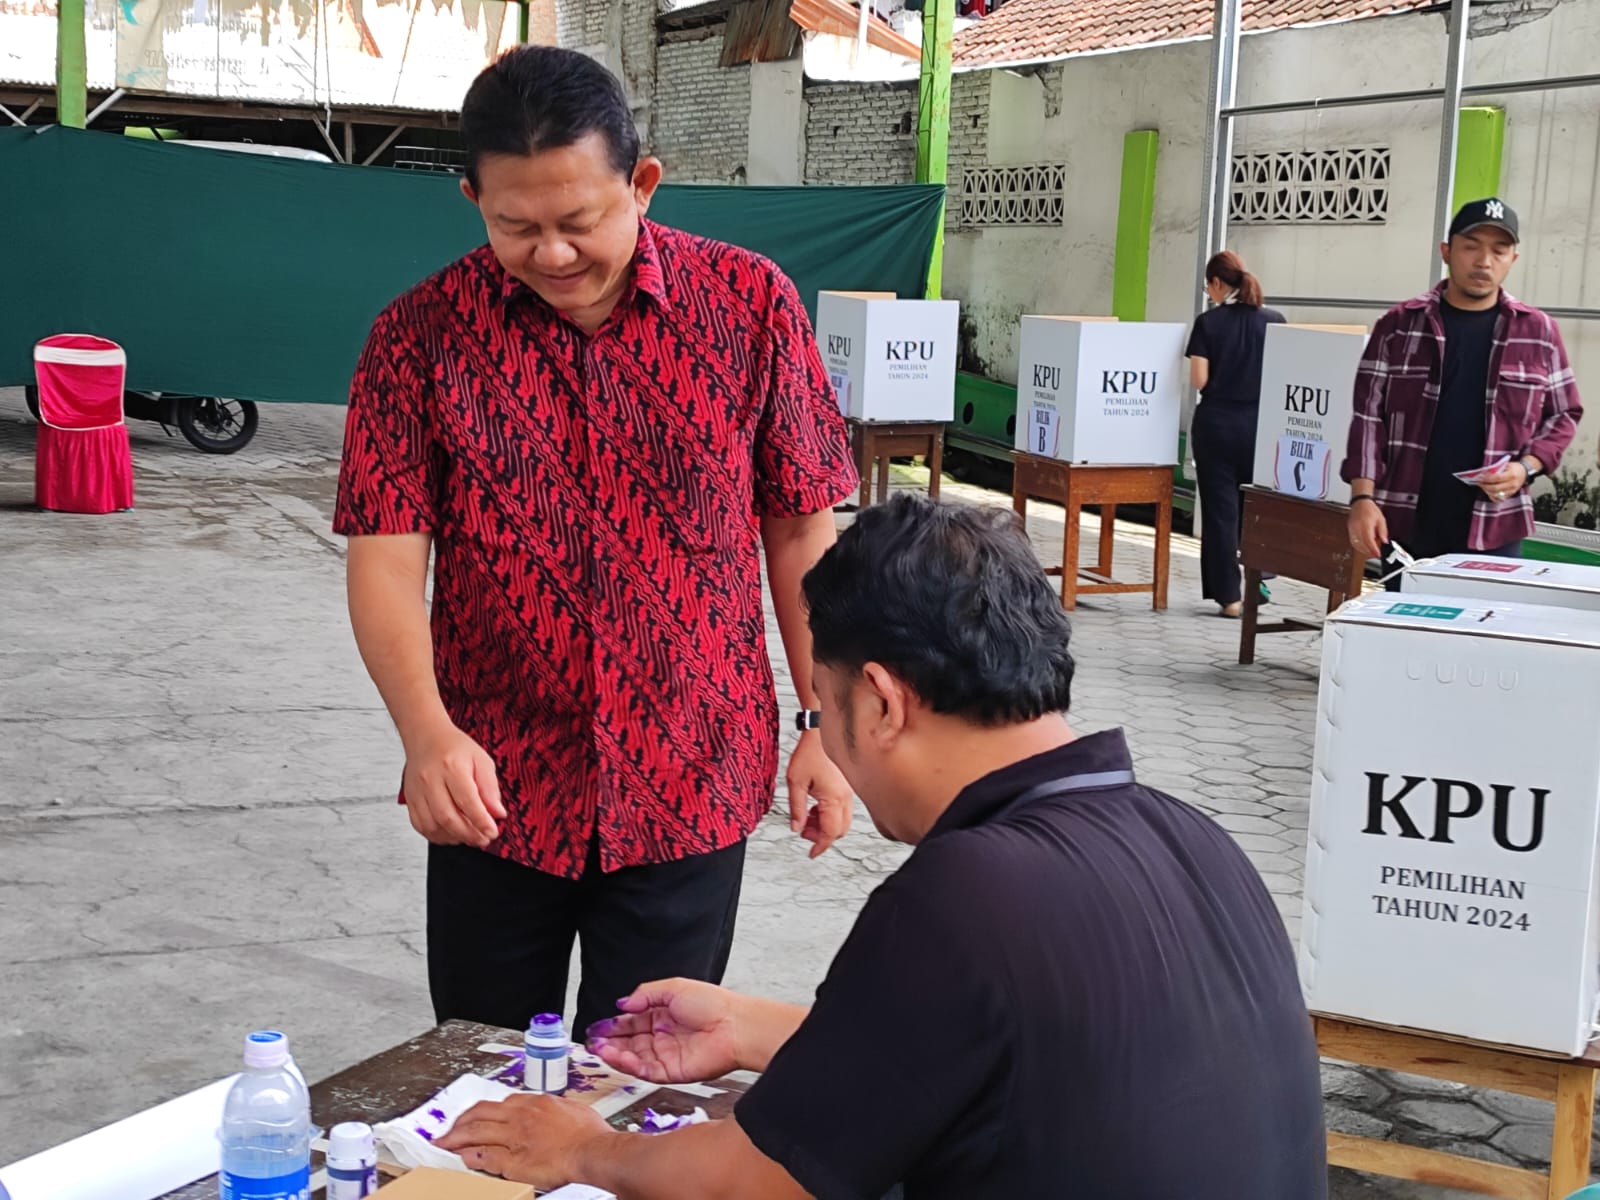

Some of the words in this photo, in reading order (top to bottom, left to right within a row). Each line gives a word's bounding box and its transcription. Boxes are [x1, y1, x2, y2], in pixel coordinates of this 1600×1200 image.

[828, 334, 851, 357] KPU
[886, 341, 935, 360] KPU
[1033, 364, 1061, 390] KPU
[1102, 370, 1157, 394] KPU
[1105, 398, 1149, 406] PEMILIHAN
[1284, 384, 1331, 416] KPU
[1287, 416, 1322, 429] PEMILIHAN
[1038, 426, 1046, 452] B
[1290, 440, 1315, 460] BILIK
[1293, 460, 1306, 492] C
[1361, 772, 1552, 852] KPU
[1380, 865, 1526, 900] PEMILIHAN
[1372, 895, 1459, 922] TAHUN
[1466, 906, 1531, 931] 2024
